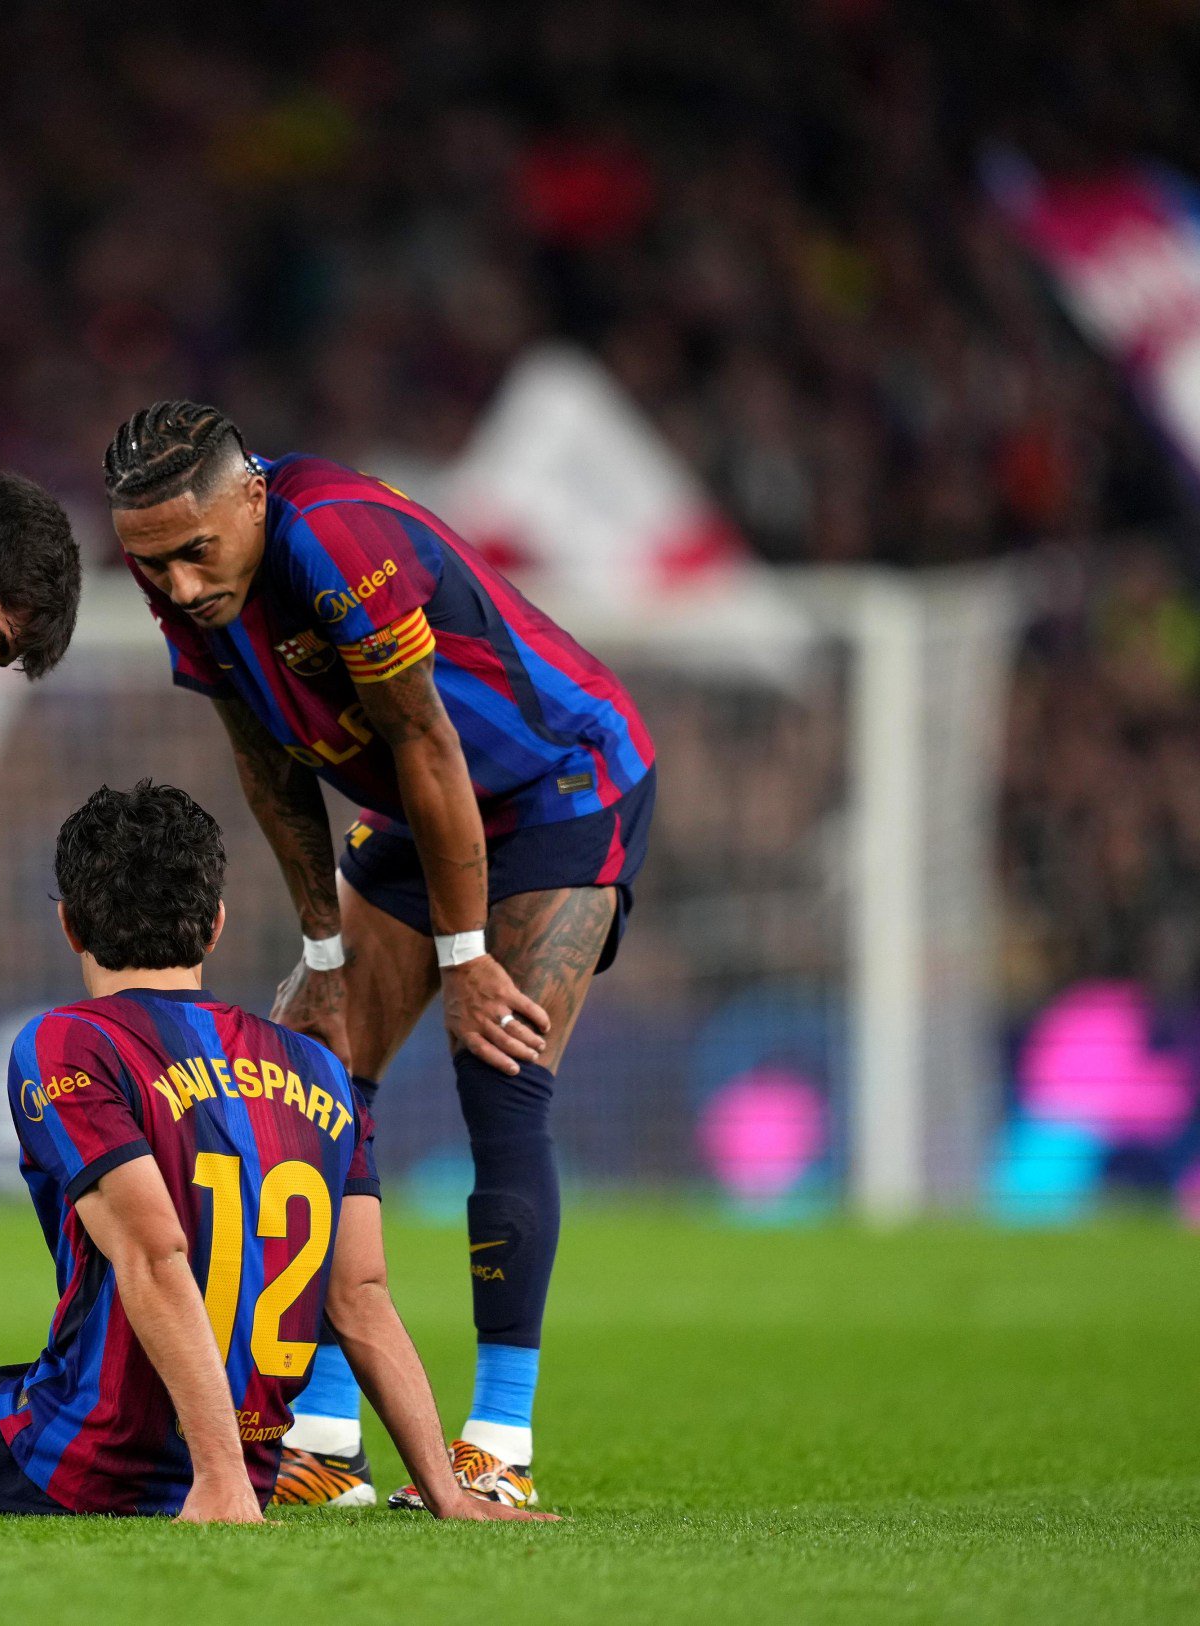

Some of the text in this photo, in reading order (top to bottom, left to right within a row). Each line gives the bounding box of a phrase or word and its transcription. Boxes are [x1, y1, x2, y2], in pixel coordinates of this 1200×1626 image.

[313, 559, 398, 623] Midea
[20, 1071, 91, 1122] Midea
[151, 1057, 353, 1142] XAVI ESPART
[192, 1152, 333, 1378] 12
